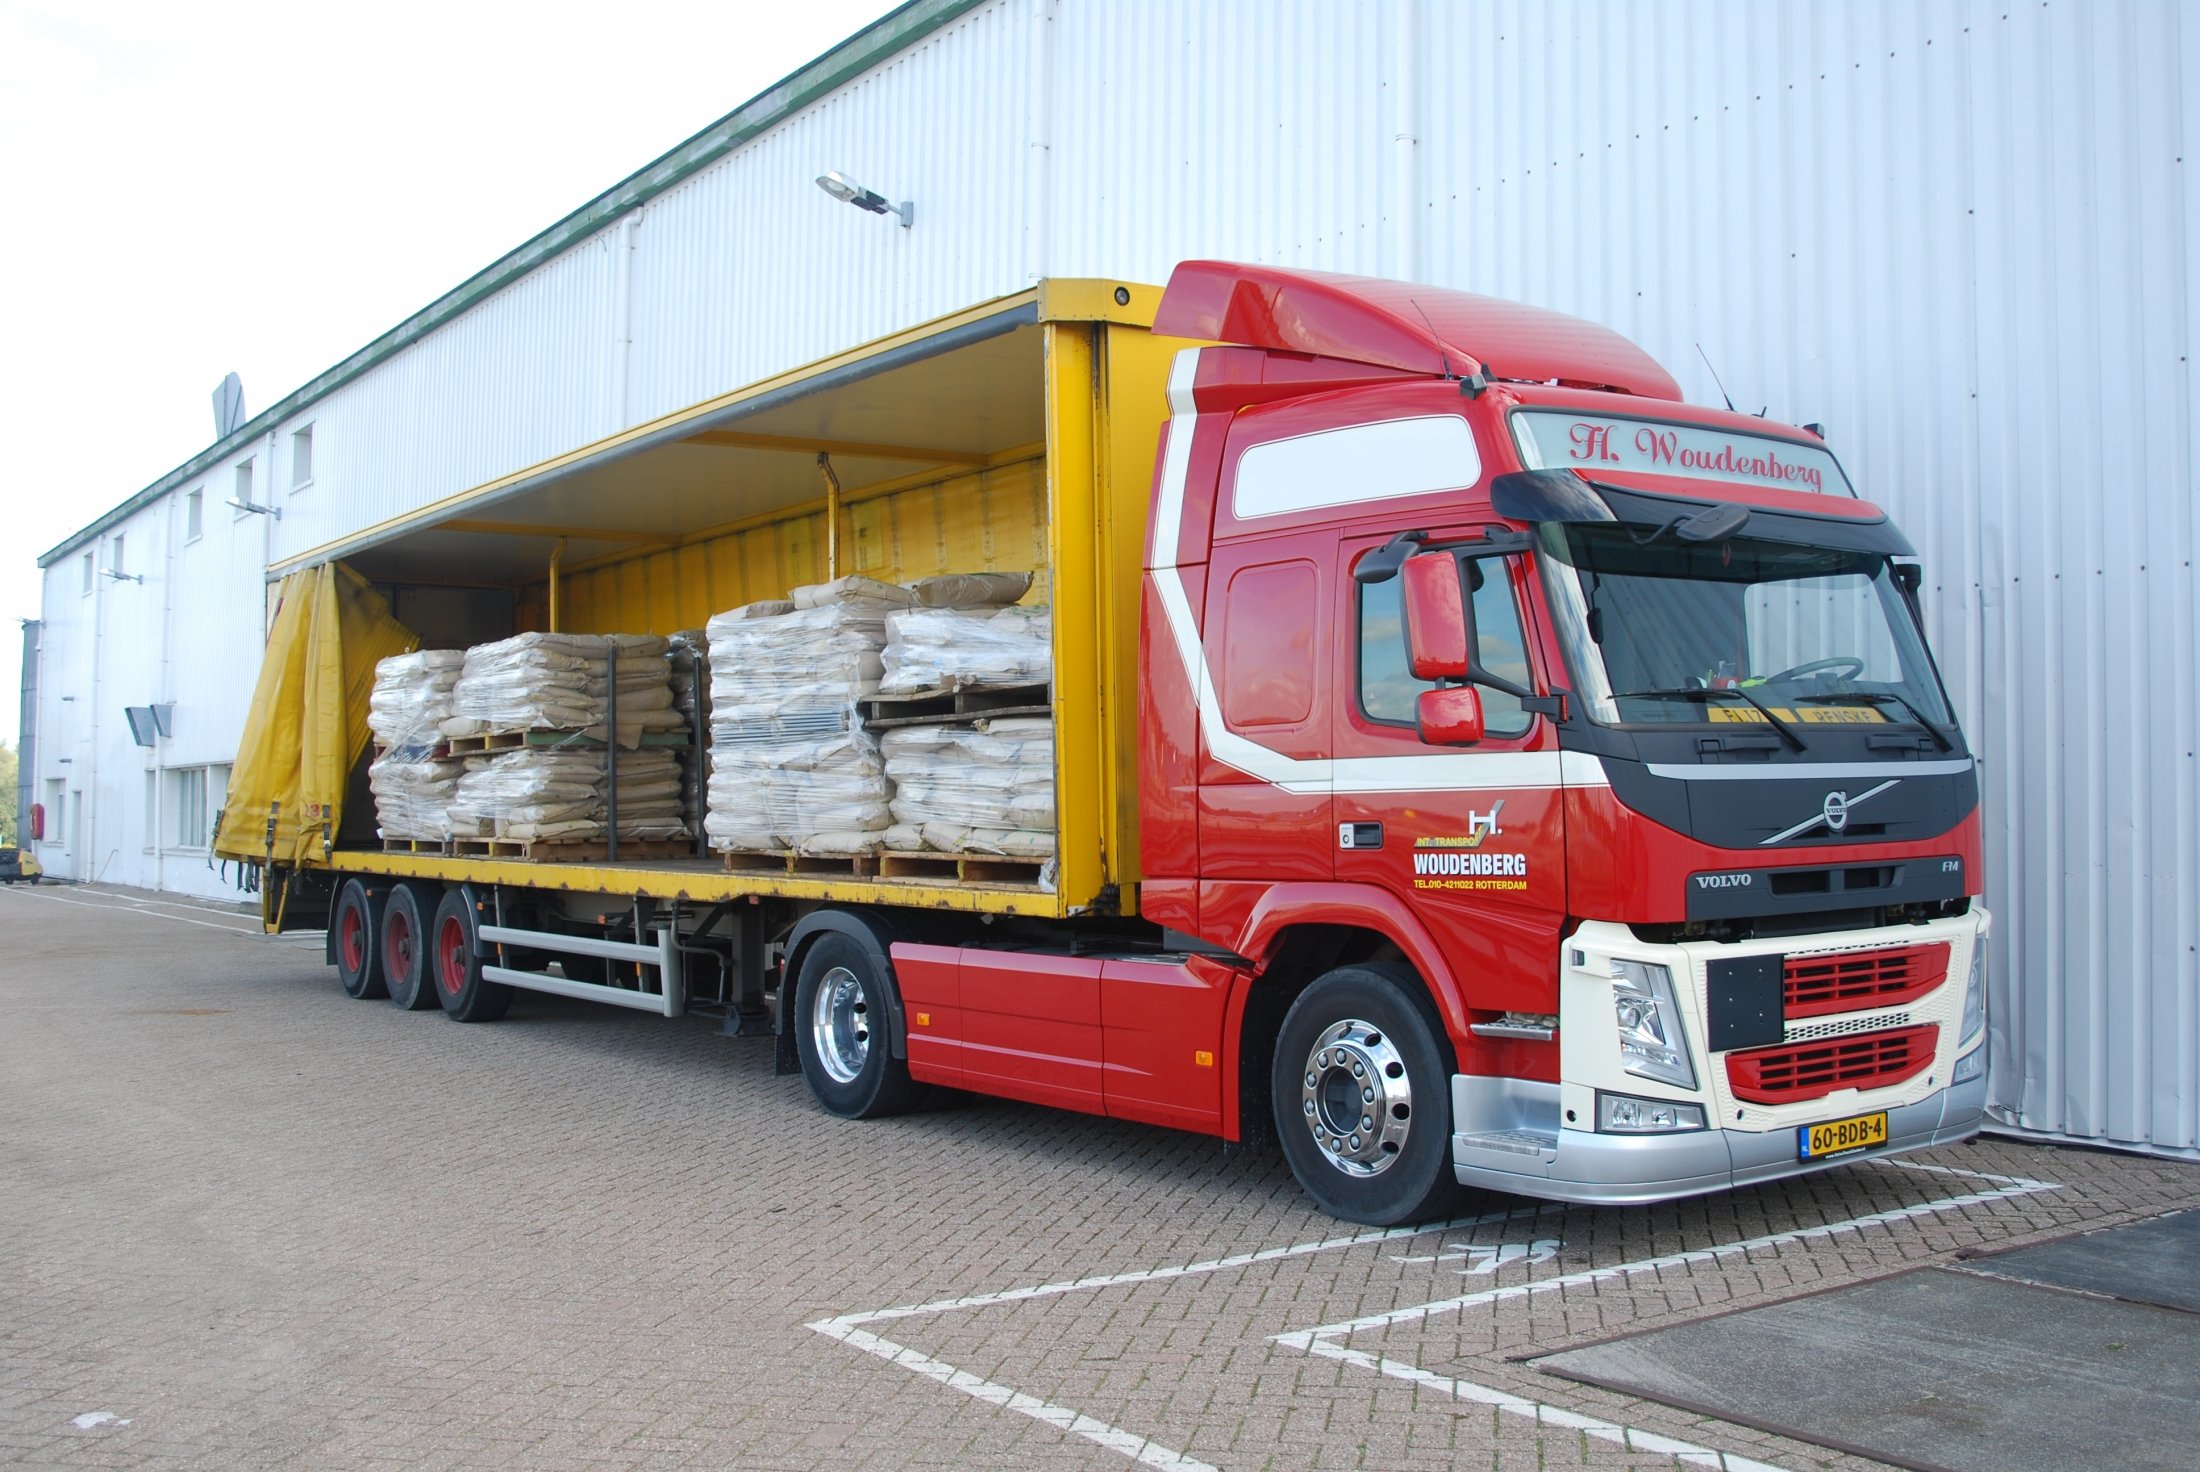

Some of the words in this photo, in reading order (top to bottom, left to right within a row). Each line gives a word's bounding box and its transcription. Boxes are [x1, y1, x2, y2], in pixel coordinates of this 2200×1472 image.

[1569, 423, 1620, 462] H.
[1635, 428, 1823, 495] Woudenberg
[1413, 853, 1526, 876] WOUDENBERG
[1941, 860, 1959, 872] FM
[1475, 880, 1527, 890] ROTTERDAM
[1695, 873, 1752, 889] VOLVO
[1812, 1117, 1882, 1150] 60-BDB-4
